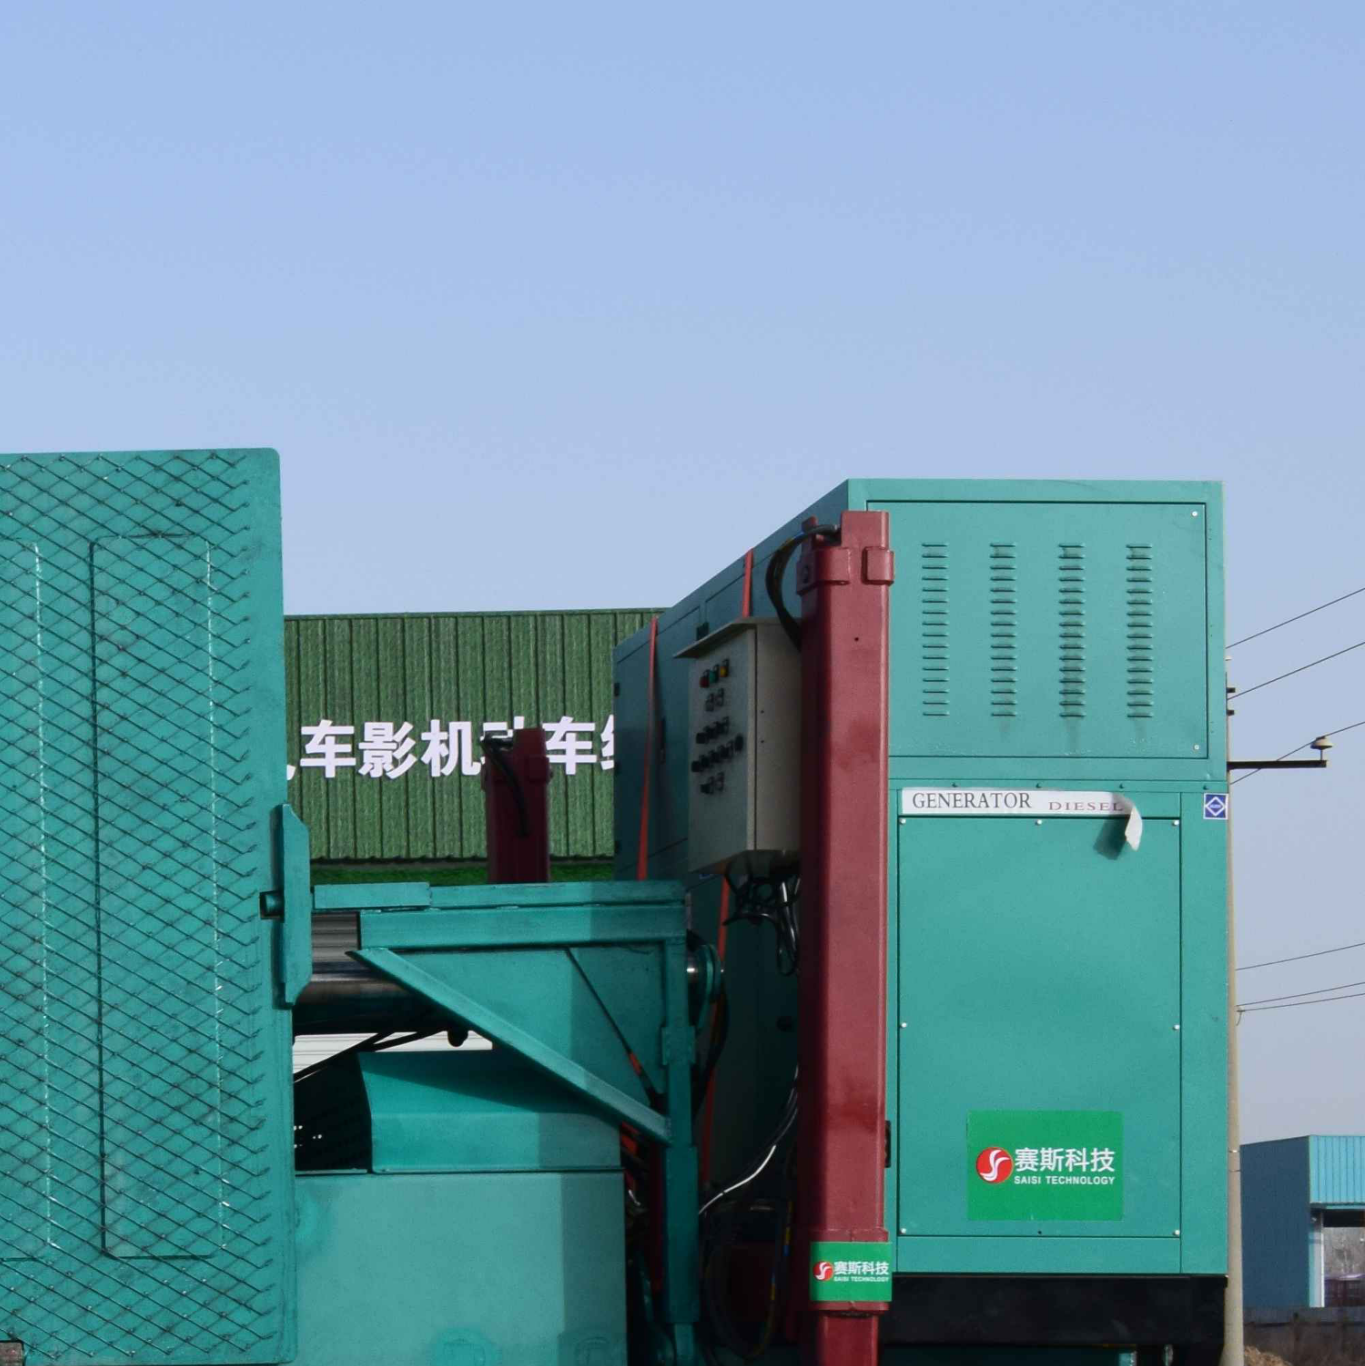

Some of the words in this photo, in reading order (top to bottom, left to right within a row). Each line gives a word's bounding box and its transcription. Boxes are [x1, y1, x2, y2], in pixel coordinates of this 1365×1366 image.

[912, 791, 1032, 809] GENERATOR
[1048, 801, 1123, 811] DIESEL
[1014, 1147, 1115, 1172] 赛斯科技
[1013, 1175, 1041, 1185] SAISI
[1046, 1175, 1115, 1185] TECHNOLOGY
[833, 1260, 889, 1275] 赛斯科技
